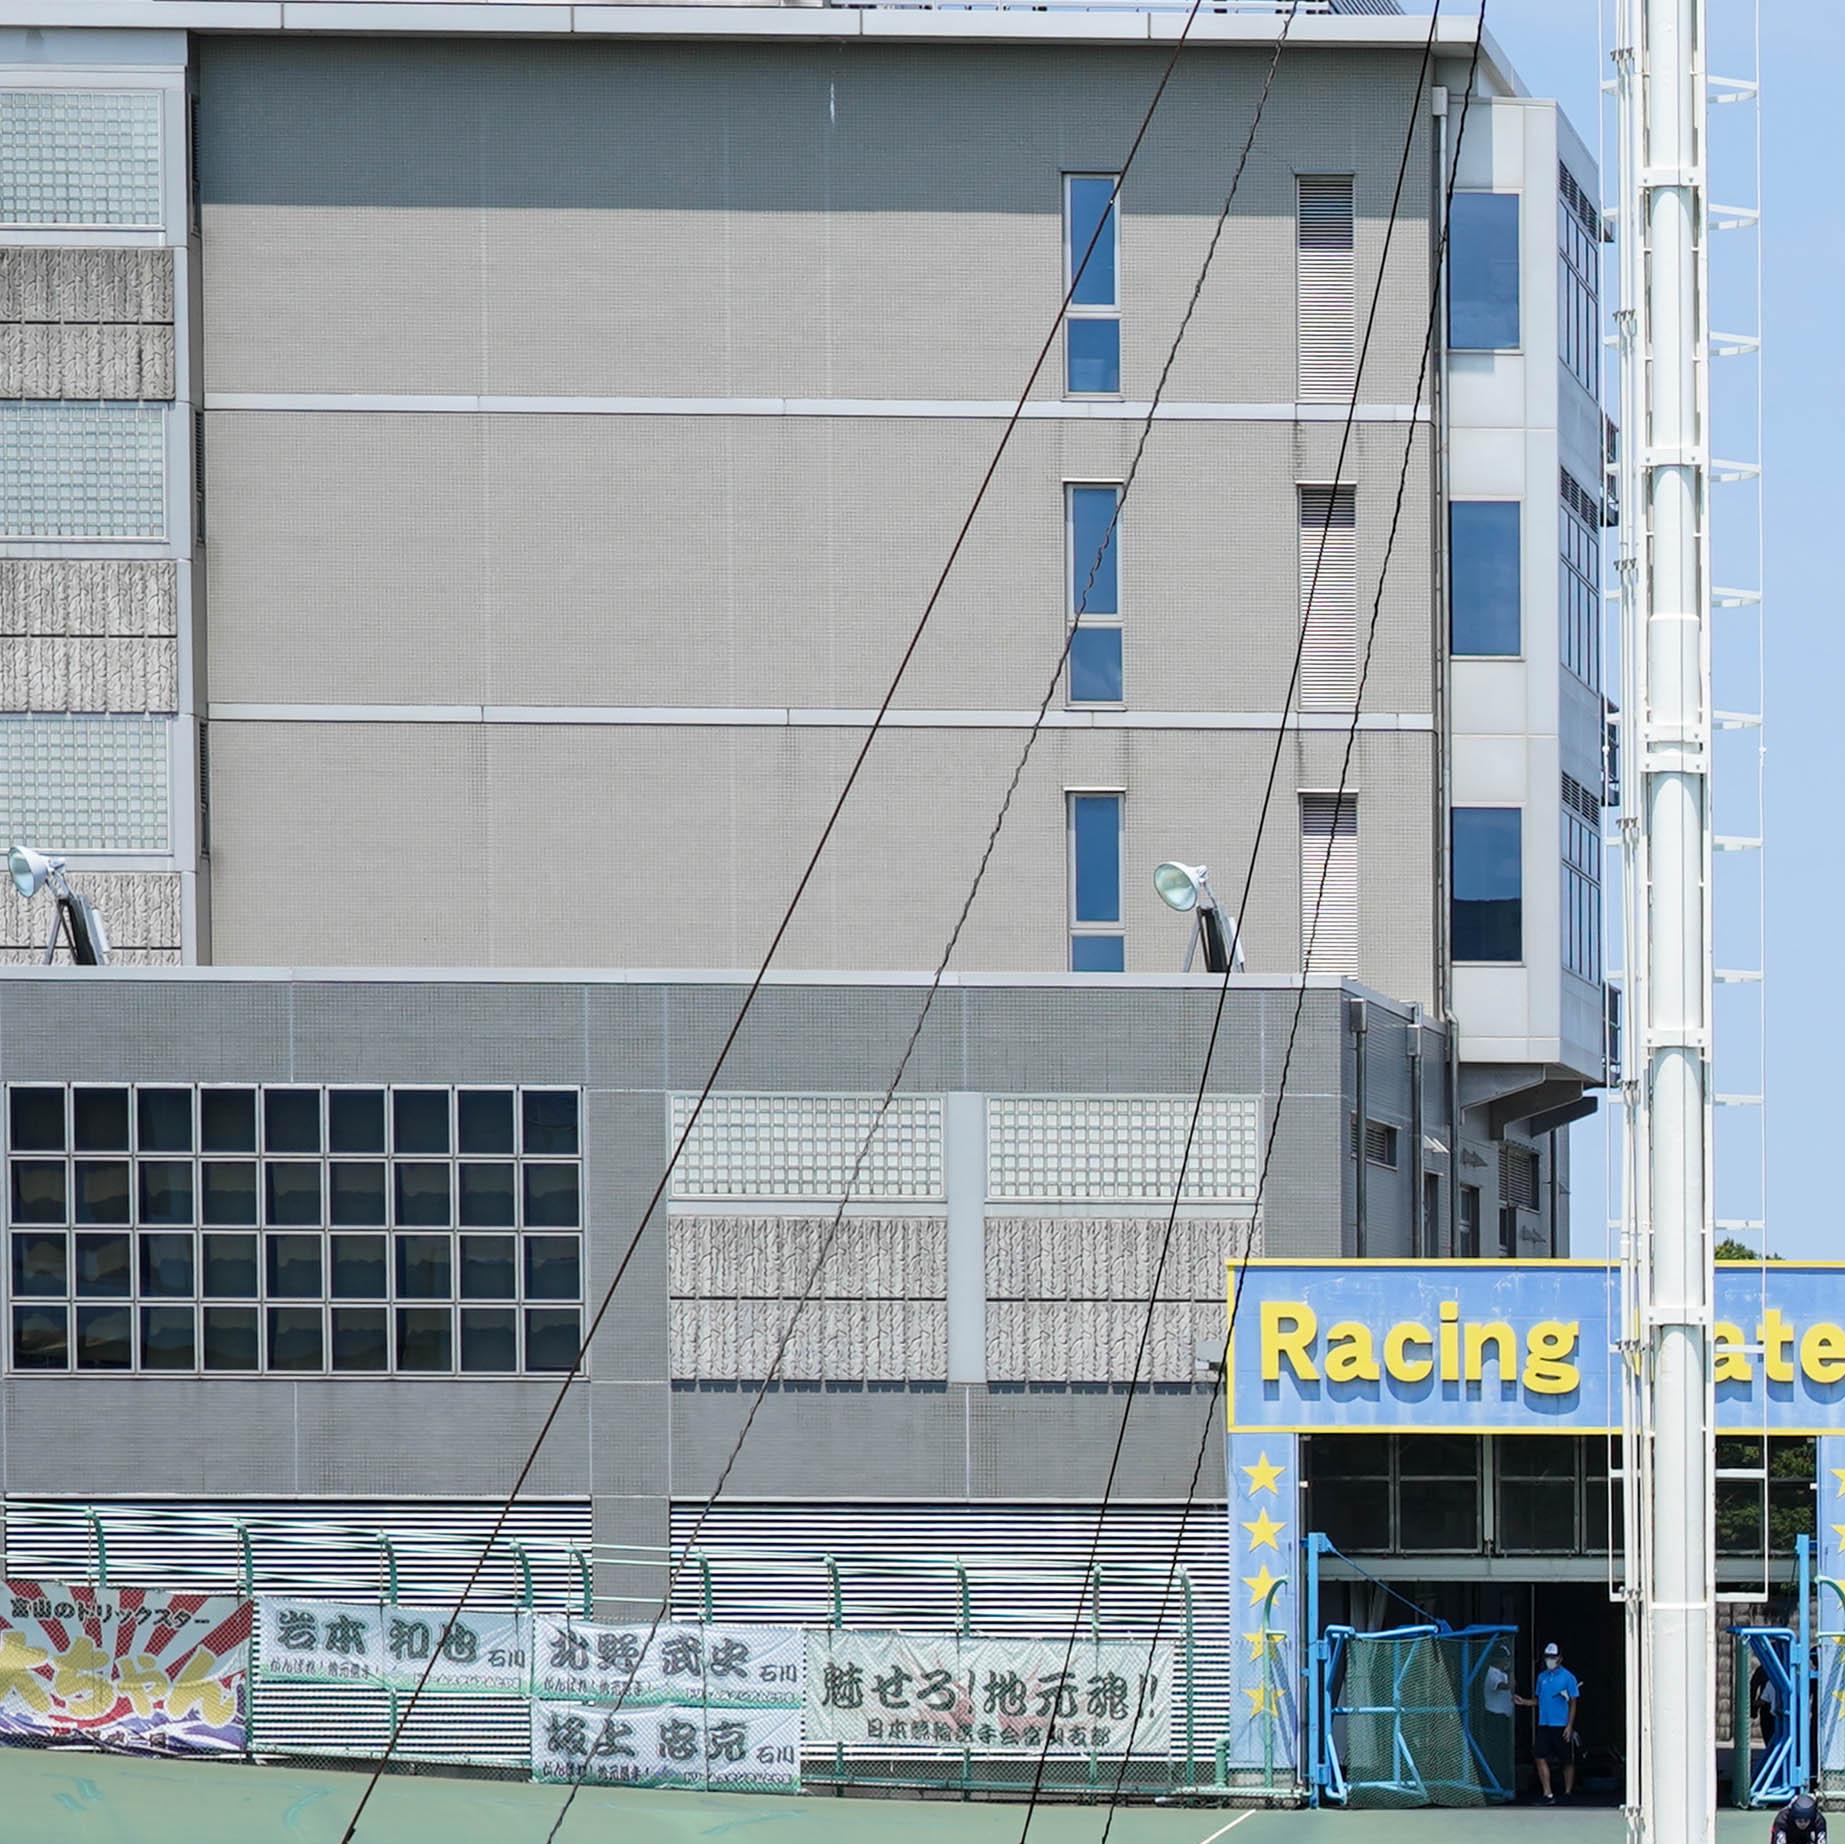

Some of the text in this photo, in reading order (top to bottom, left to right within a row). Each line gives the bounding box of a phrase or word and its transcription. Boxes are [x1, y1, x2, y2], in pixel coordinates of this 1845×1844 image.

[1258, 1301, 1582, 1395] Racing
[275, 1609, 526, 1669] 岩本和也 石川
[549, 1630, 798, 1684] 北野武史 石川
[756, 1745, 796, 1765] 石川
